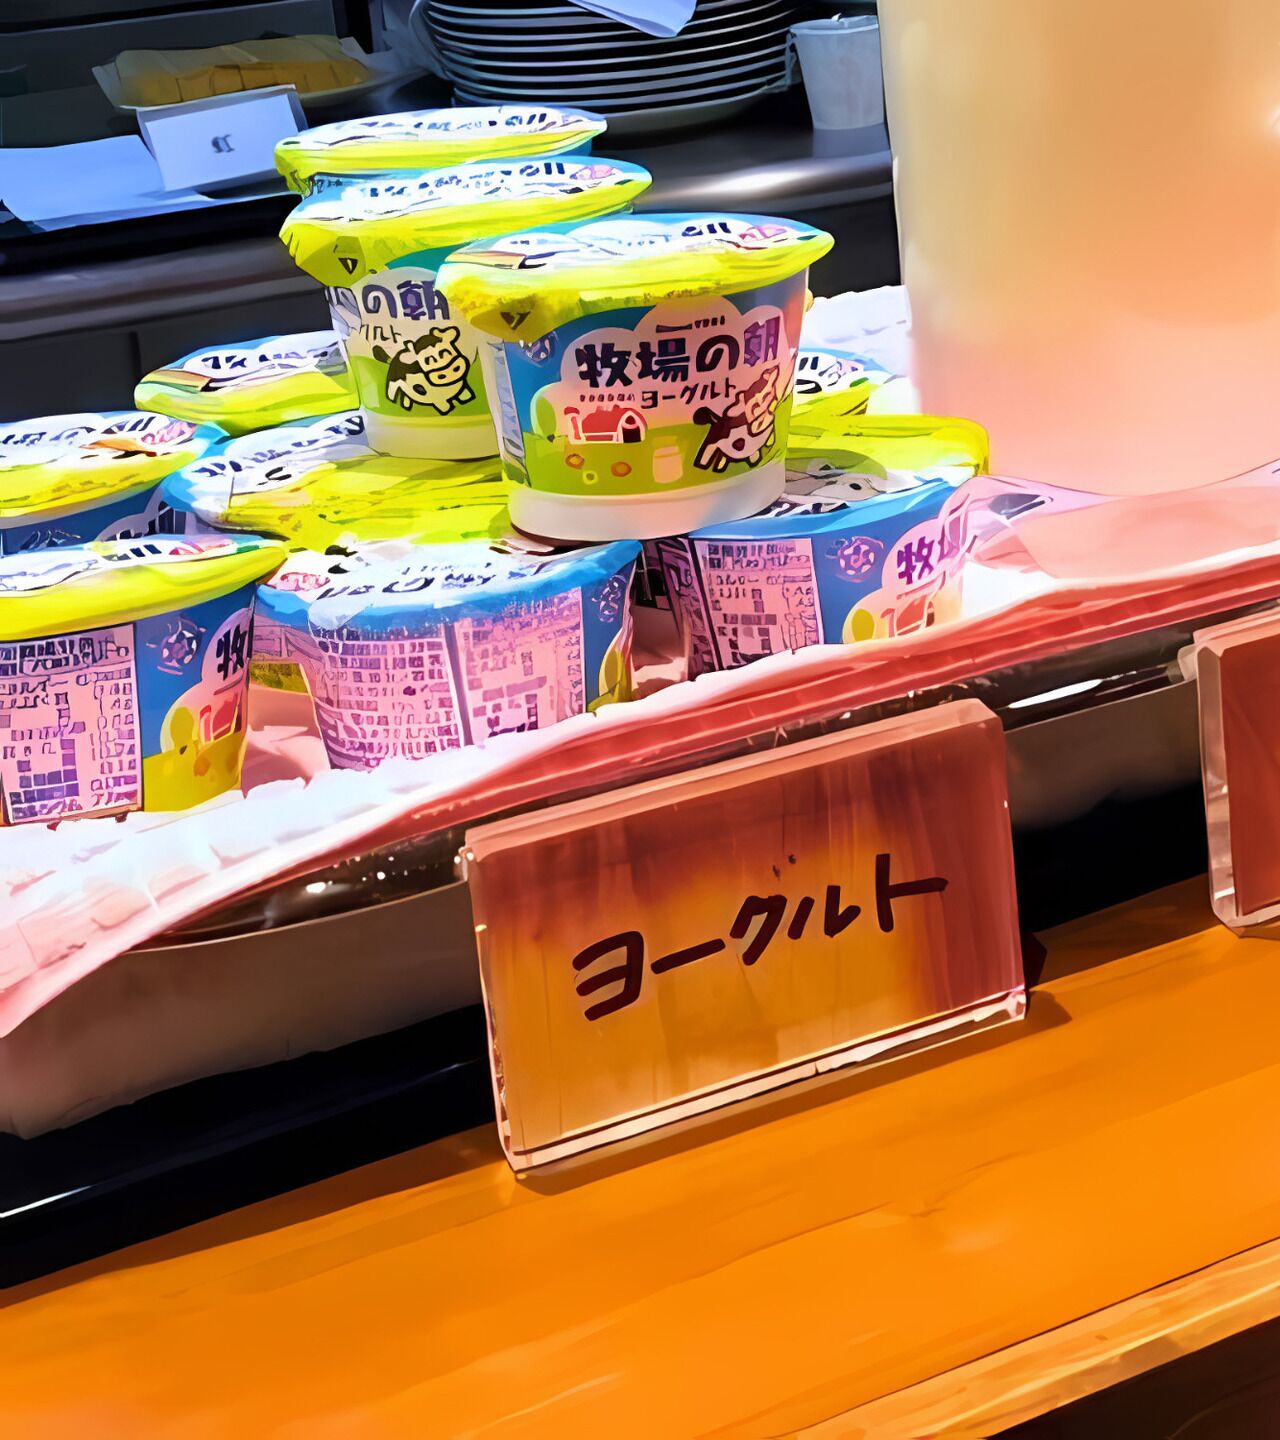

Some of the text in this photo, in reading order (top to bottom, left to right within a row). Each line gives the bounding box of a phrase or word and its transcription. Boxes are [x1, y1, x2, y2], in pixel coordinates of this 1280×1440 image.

[575, 316, 780, 388] 牧場の朝
[641, 377, 736, 409] ヨーグルト
[571, 853, 948, 1021] ヨーグルト
